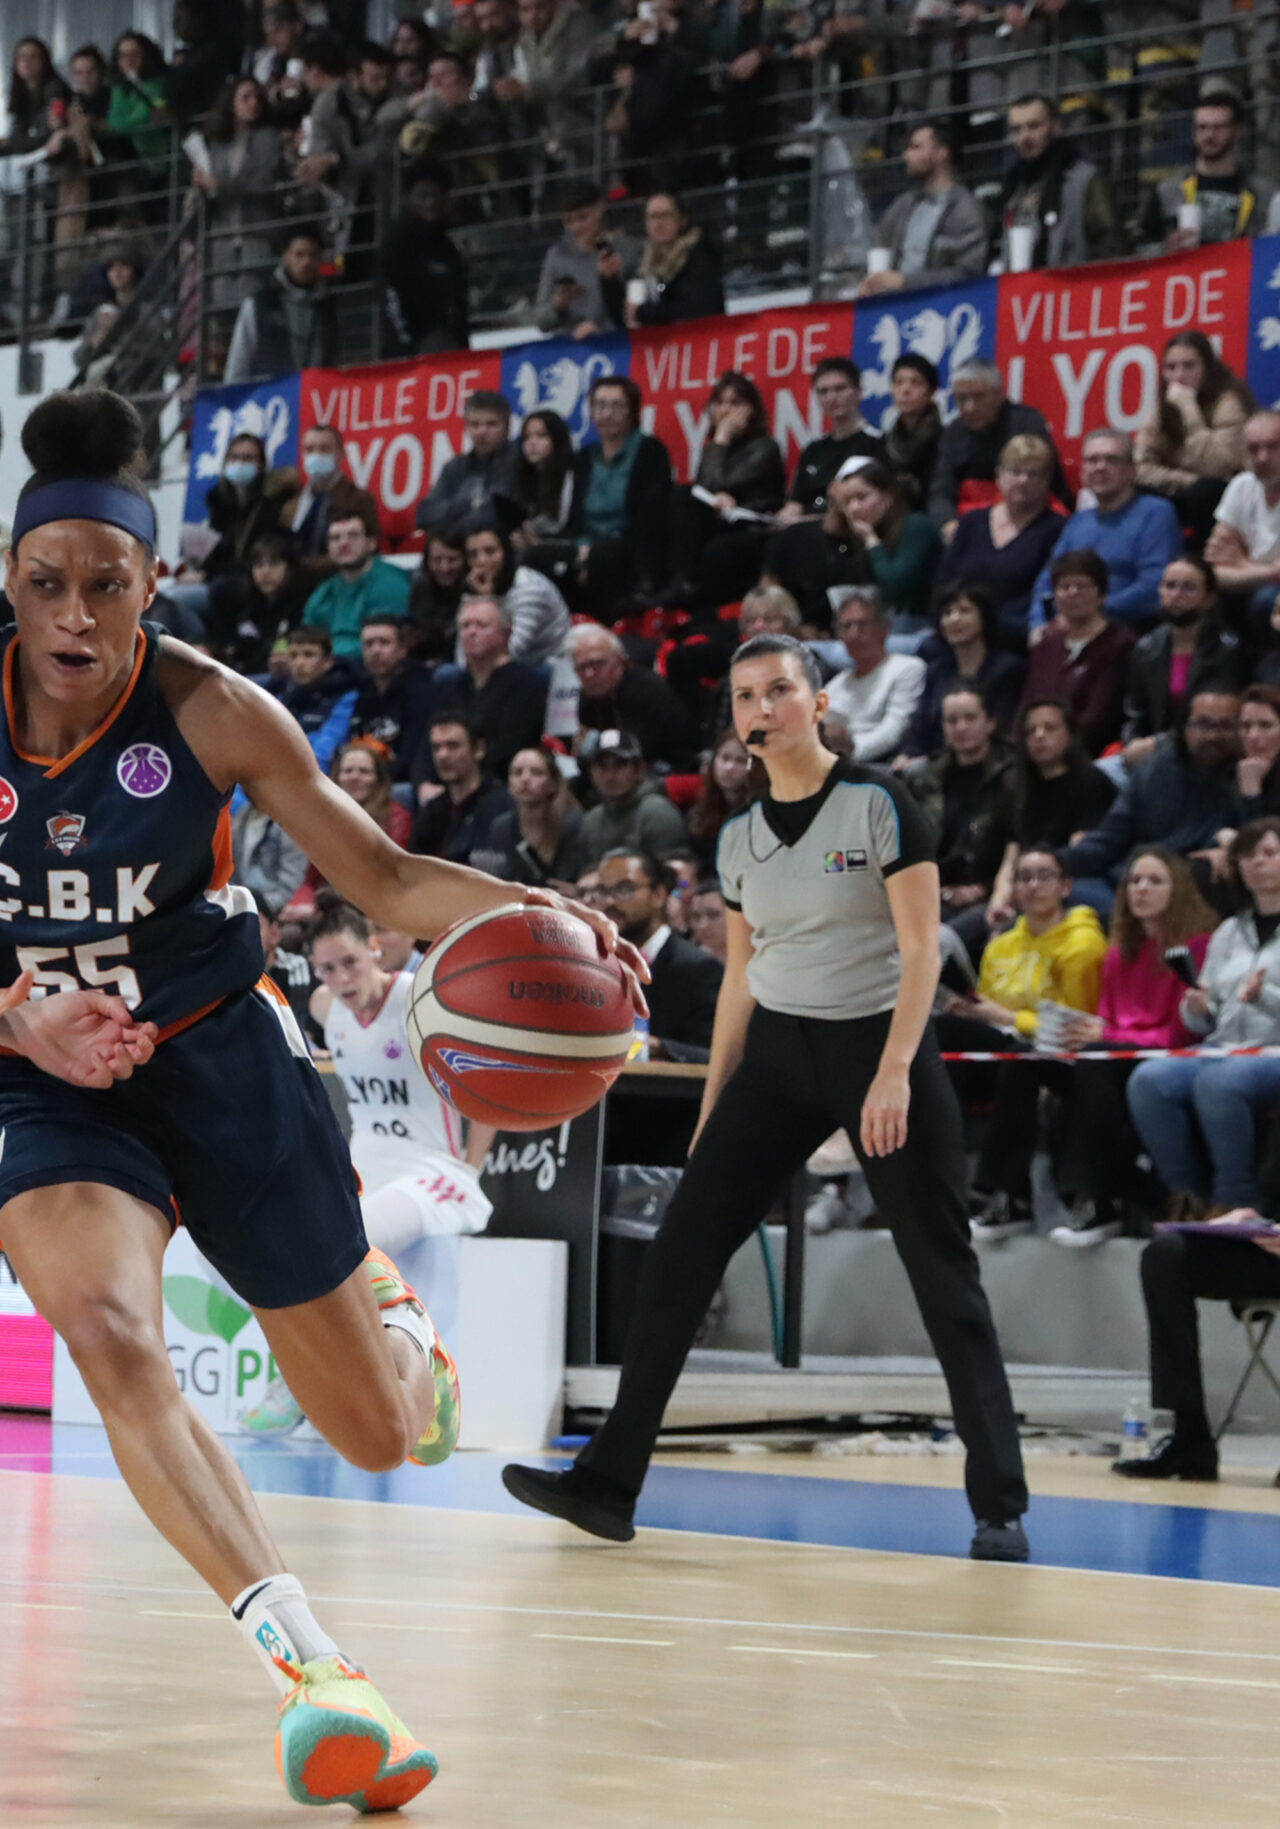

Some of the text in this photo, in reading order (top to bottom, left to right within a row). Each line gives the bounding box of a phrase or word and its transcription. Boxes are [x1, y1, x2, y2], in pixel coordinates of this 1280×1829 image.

[1010, 267, 1228, 344] VILLE DE
[644, 322, 830, 394] VILLE DE
[1006, 333, 1223, 440] YO
[310, 369, 481, 432] VILLE DE
[15, 934, 144, 1012] 55
[508, 980, 606, 1009] molten
[348, 1074, 410, 1106] YON
